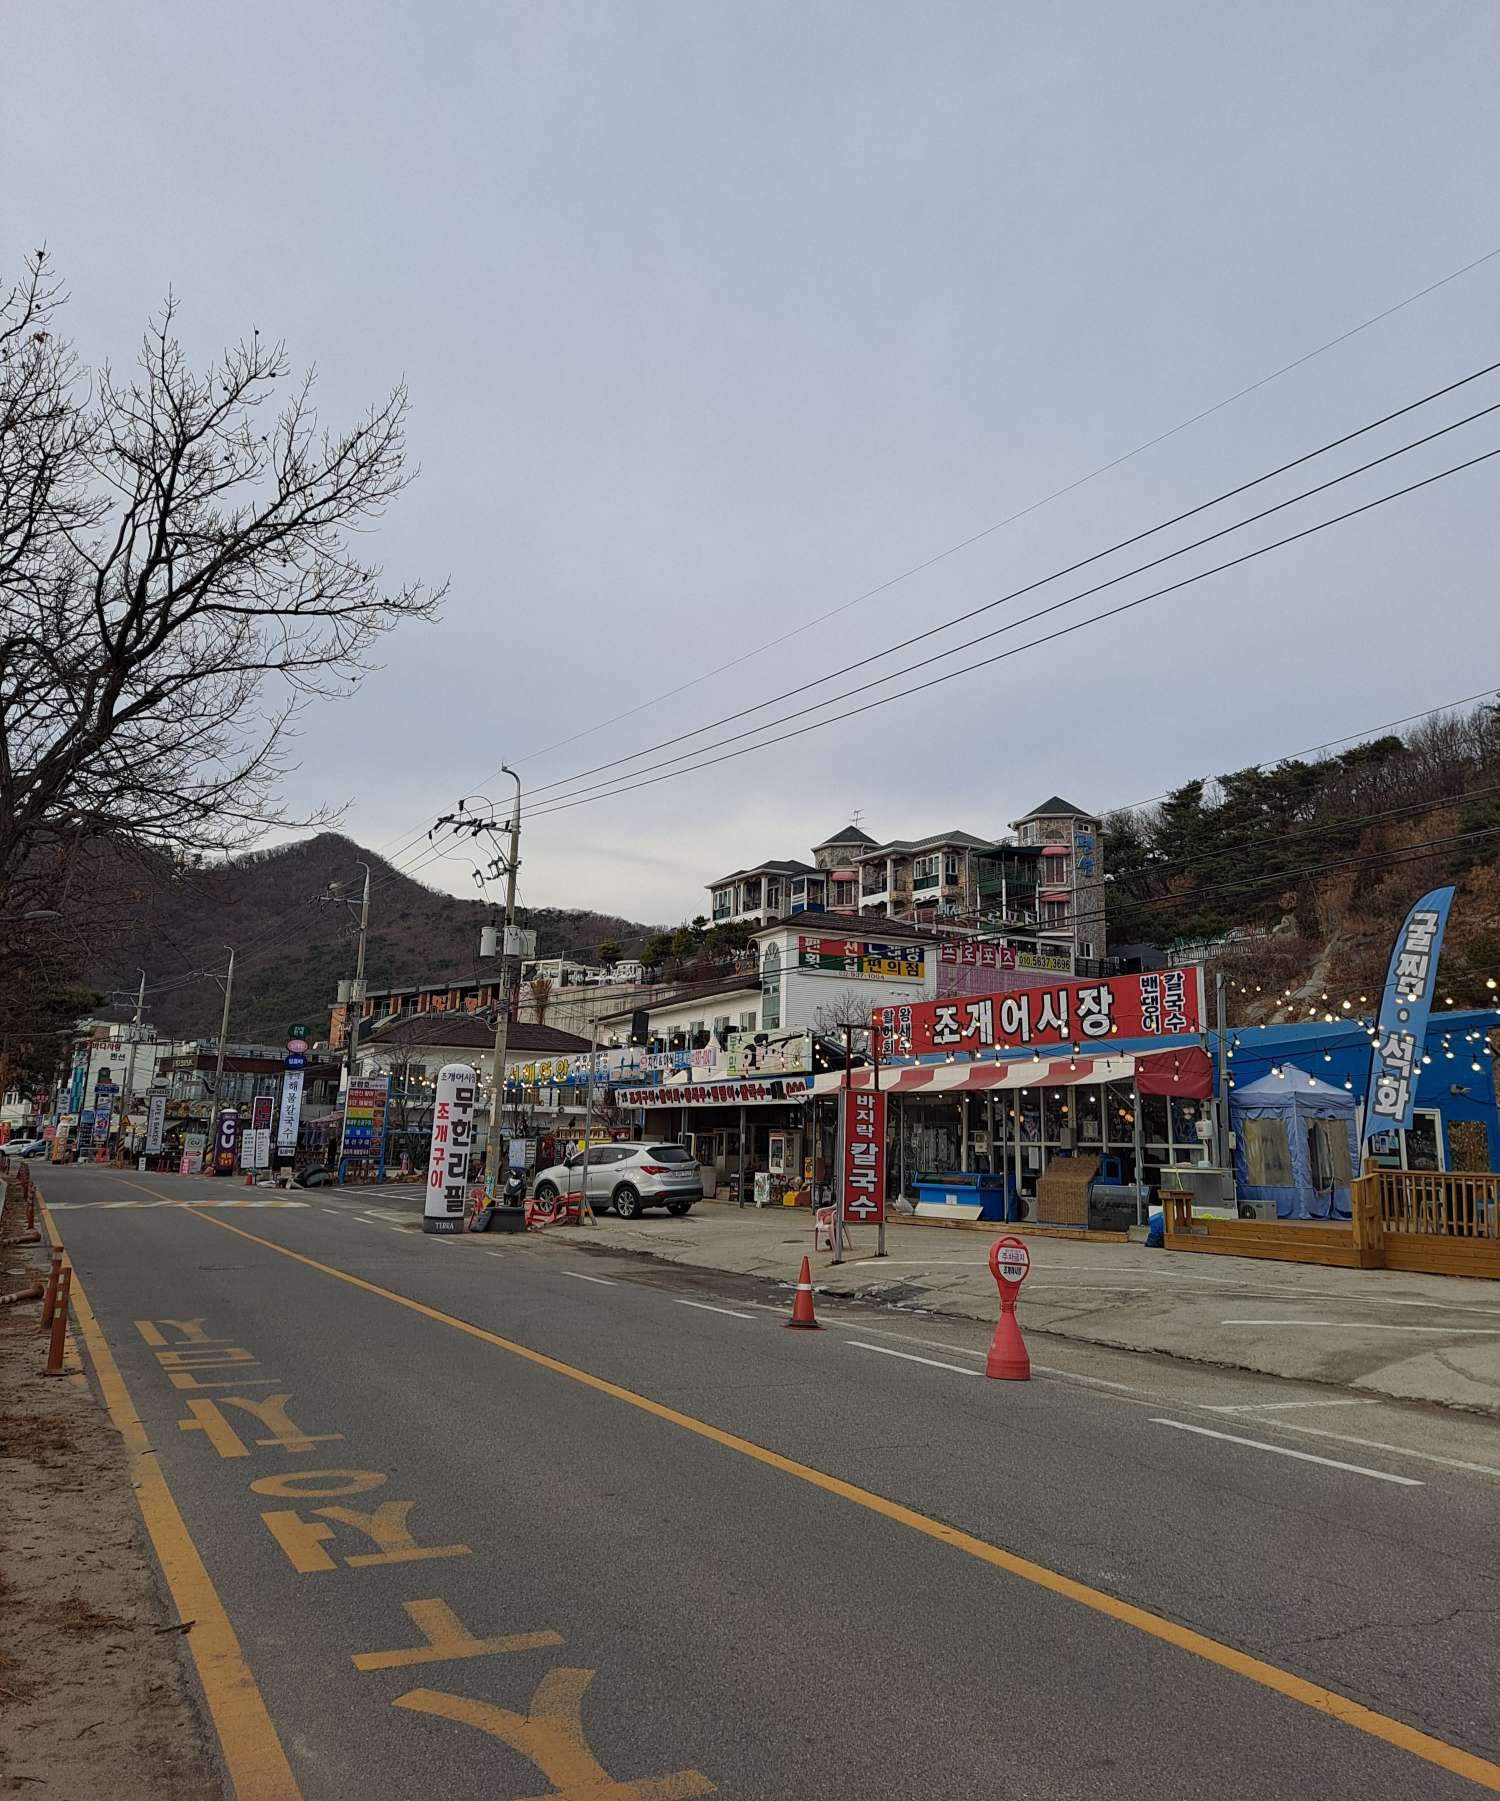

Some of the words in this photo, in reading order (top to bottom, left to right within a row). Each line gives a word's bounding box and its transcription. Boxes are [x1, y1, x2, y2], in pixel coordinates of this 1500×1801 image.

[867, 959, 919, 977] 편의점
[1396, 912, 1438, 998] 굴찜
[932, 984, 1114, 1046] 조개어시장
[1140, 974, 1161, 1034] 밴댕이
[1163, 971, 1186, 1033] 칼국수
[1374, 1033, 1416, 1122] 석화
[221, 1120, 235, 1148] CU
[282, 1080, 298, 1139] 해물칼국수
[856, 1095, 875, 1138] 바지락
[430, 1102, 450, 1189] 조개구이
[444, 1086, 474, 1214] 무한리필
[849, 1142, 878, 1219] 칼국수
